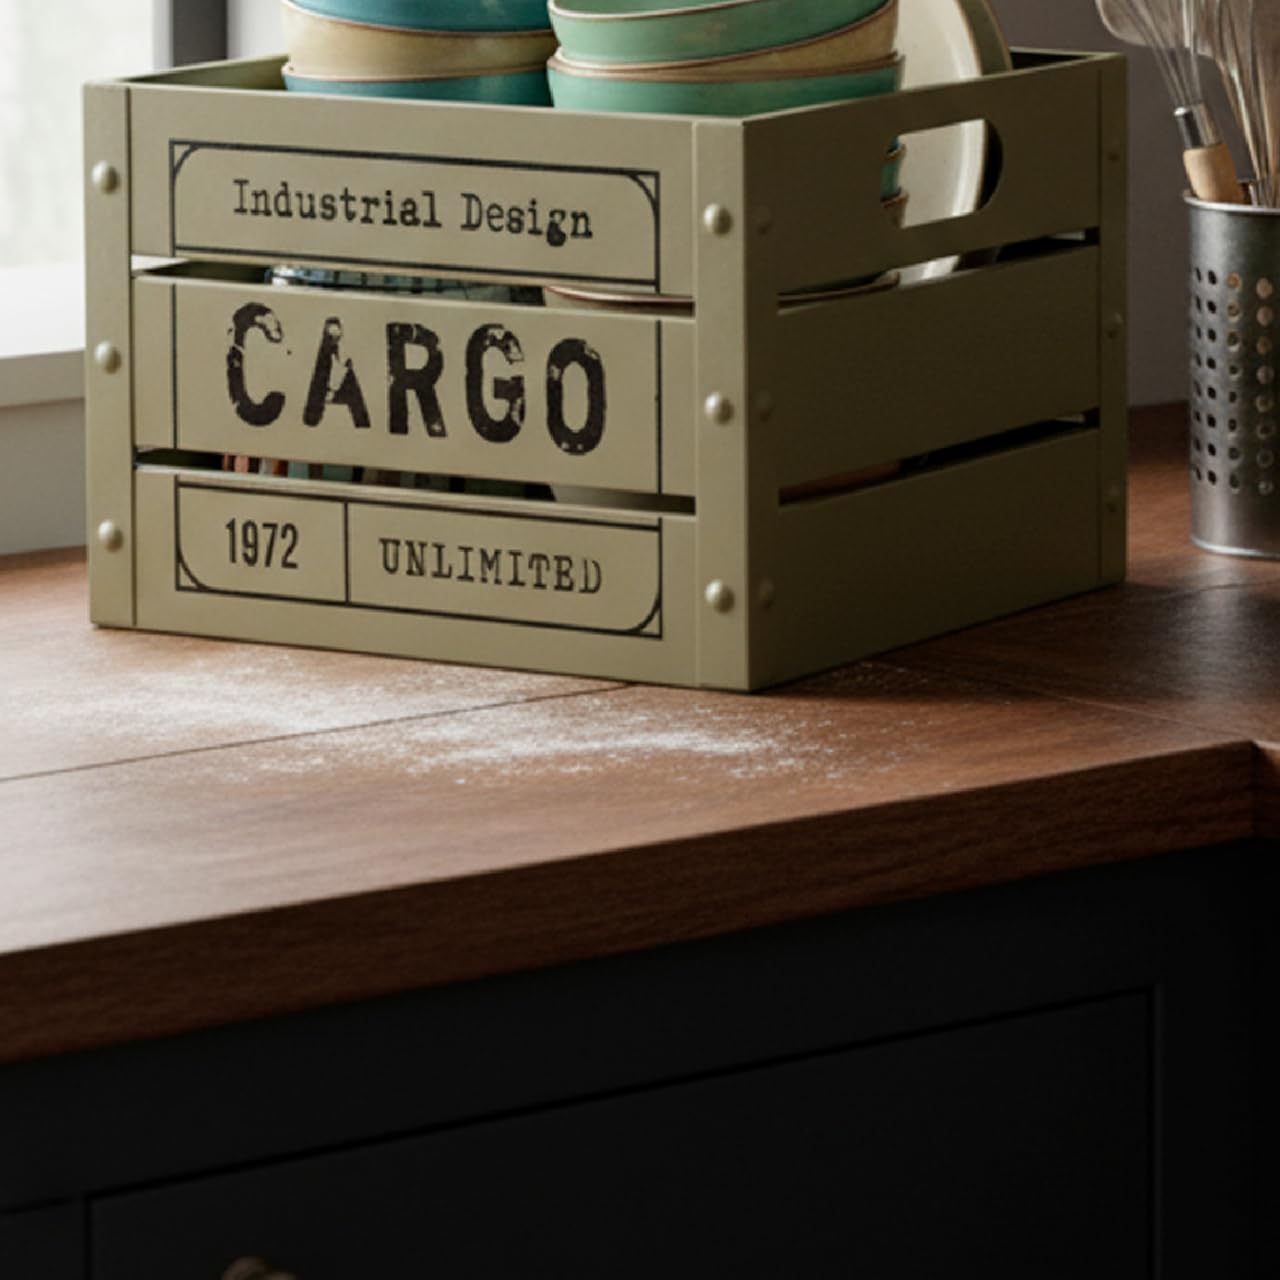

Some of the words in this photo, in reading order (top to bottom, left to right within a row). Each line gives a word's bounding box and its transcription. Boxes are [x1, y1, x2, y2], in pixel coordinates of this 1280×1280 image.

[231, 178, 443, 230] Industrial
[460, 192, 594, 247] Design
[225, 301, 608, 457] CARGO
[225, 518, 299, 570] 1972
[379, 537, 603, 595] UNLIMITED
